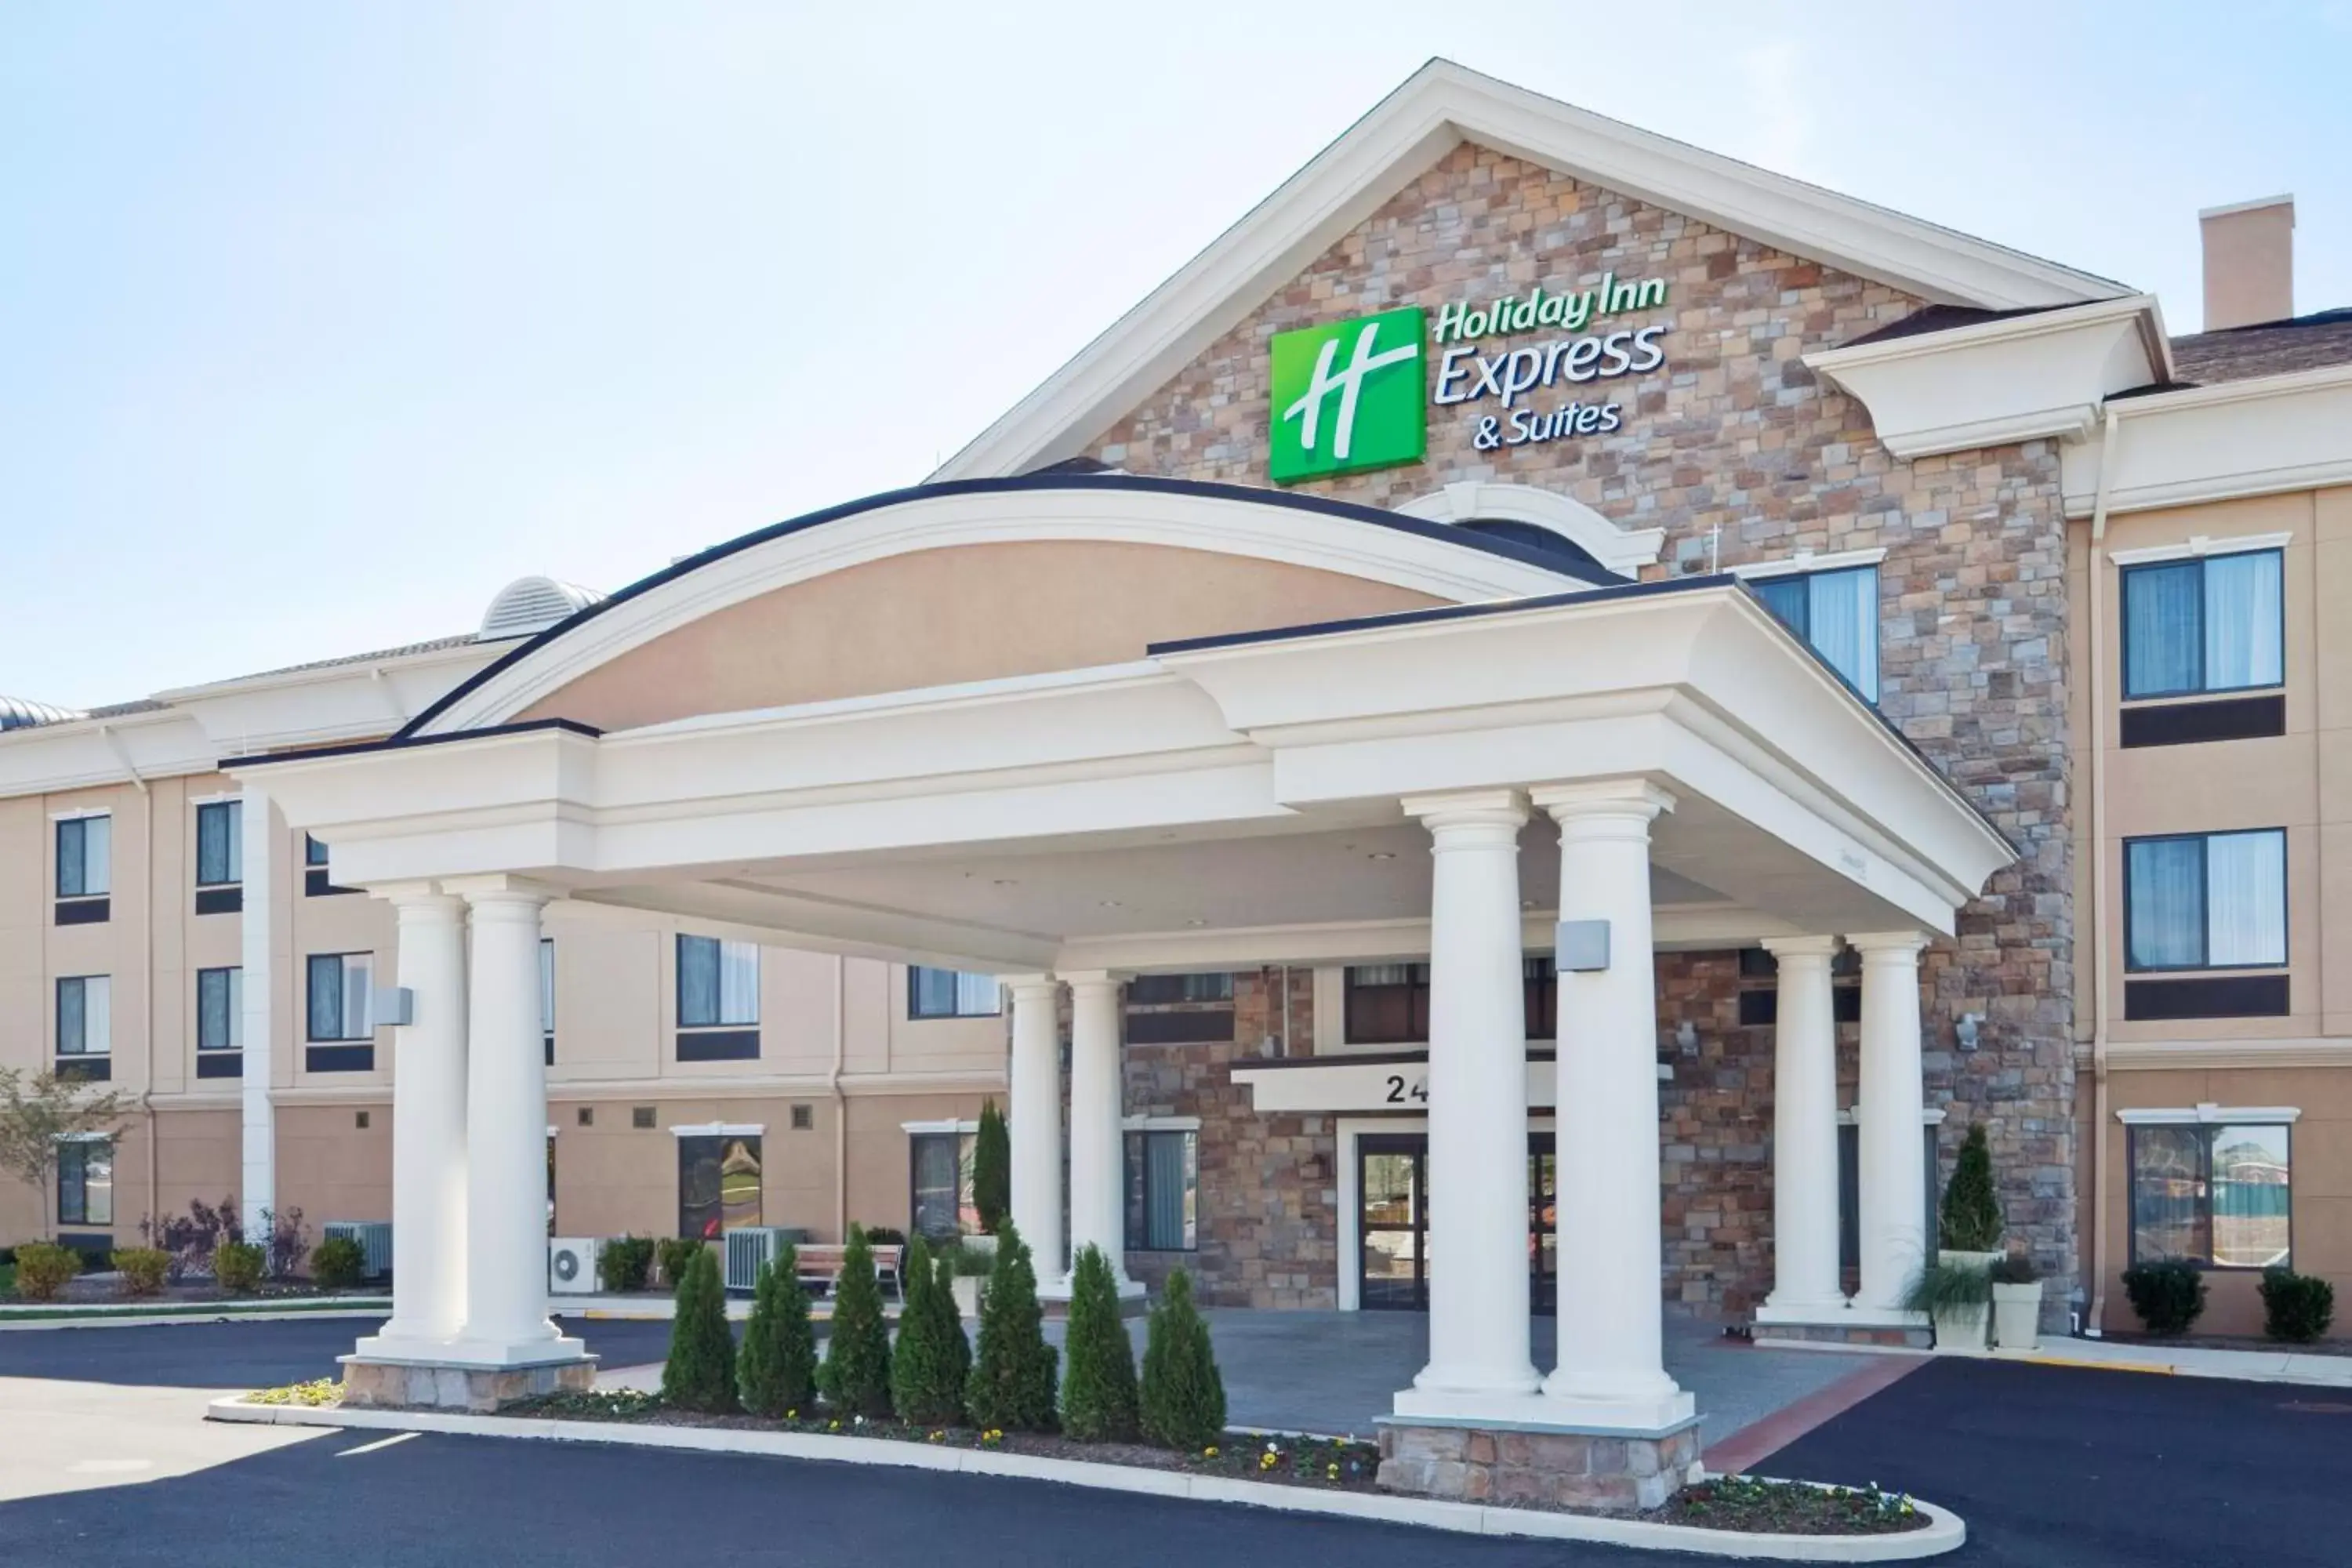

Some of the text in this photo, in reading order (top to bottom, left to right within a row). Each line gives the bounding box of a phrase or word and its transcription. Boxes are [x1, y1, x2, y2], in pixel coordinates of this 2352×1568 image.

[1433, 272, 1666, 343] Holiday Inn
[1434, 325, 1666, 408] Express
[1473, 402, 1621, 450] & Suites
